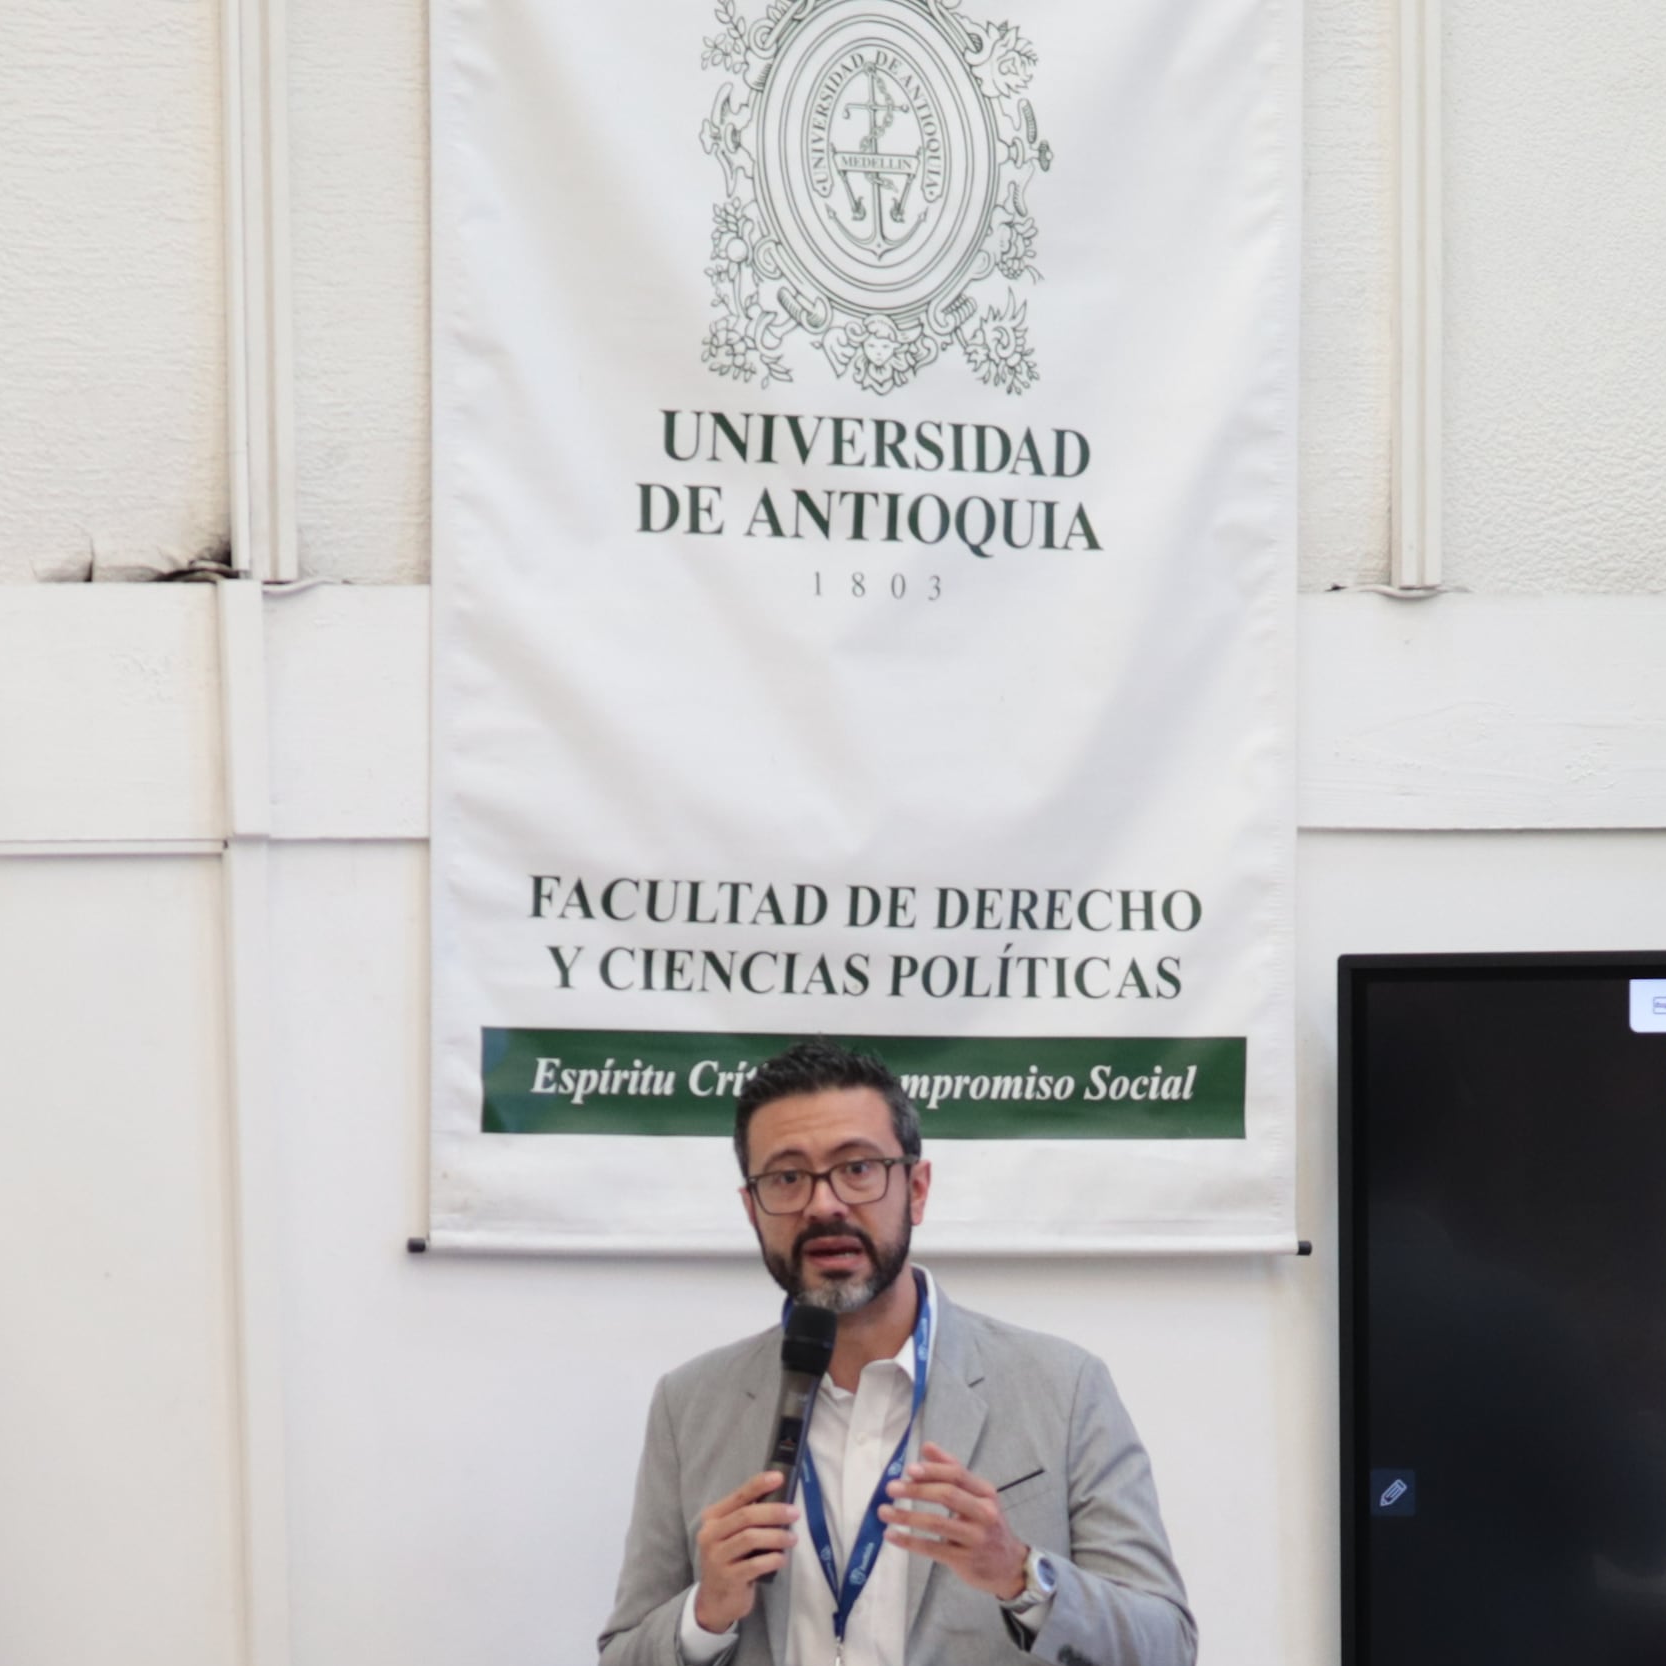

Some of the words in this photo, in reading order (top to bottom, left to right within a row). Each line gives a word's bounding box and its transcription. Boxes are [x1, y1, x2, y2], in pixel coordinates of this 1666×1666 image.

[811, 52, 865, 185] UNIVERSIDAD
[875, 50, 902, 75] DE
[900, 74, 941, 188] ANTIOQUIA
[660, 409, 1090, 478] UNIVERSIDAD
[635, 482, 725, 535] DE
[743, 487, 1104, 558] ANTIOQUIA
[528, 874, 829, 928] FACULTAD
[846, 885, 917, 930] DE
[934, 887, 1203, 933] DERECHO
[545, 945, 586, 990] Y
[599, 948, 871, 997] CIENCIAS
[889, 943, 1183, 1000] POLÍTICAS
[531, 1056, 676, 1105] Espíritu
[900, 1066, 1076, 1110] mpromiso
[1084, 1065, 1198, 1103] Social
